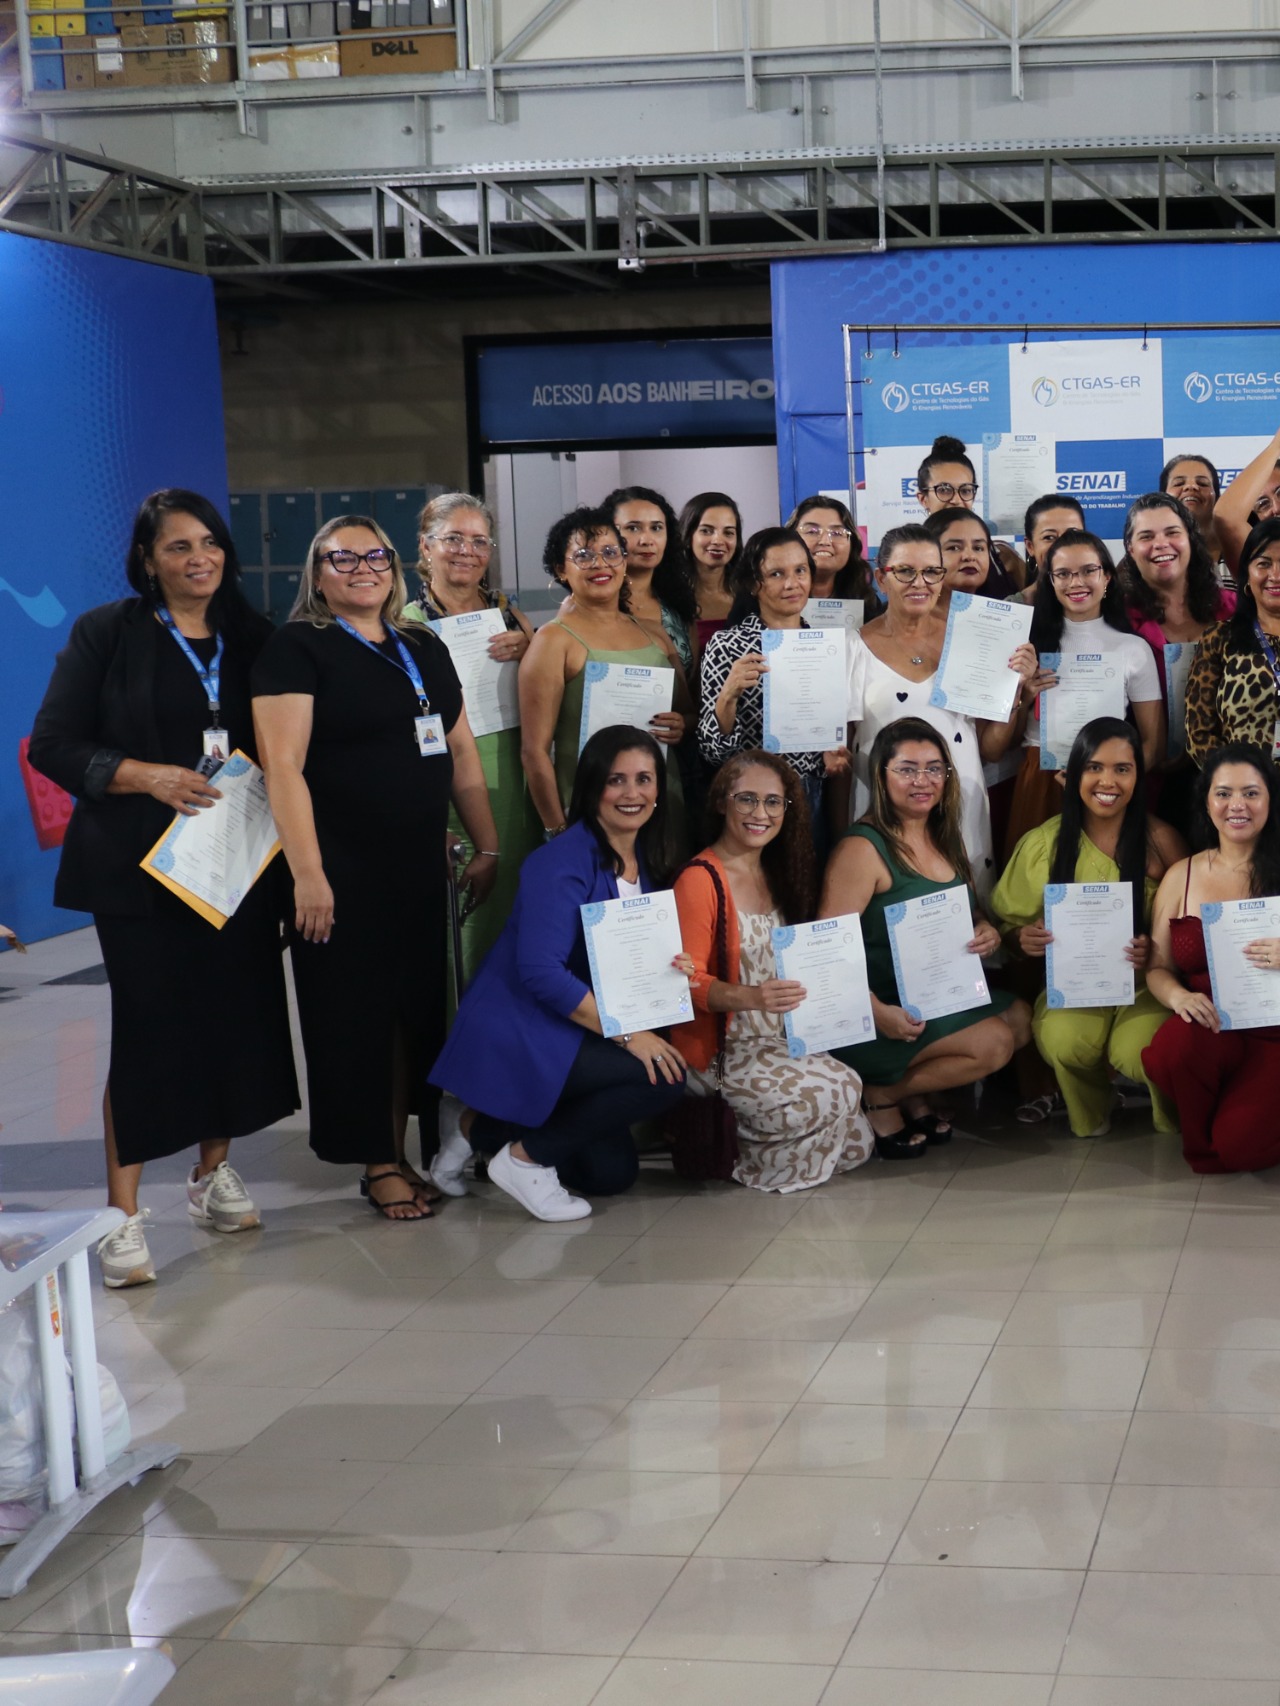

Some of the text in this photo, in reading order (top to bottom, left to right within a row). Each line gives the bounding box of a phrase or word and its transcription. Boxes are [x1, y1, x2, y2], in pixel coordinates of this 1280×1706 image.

[372, 40, 418, 56] DELL
[911, 380, 989, 396] CTGAS-ER
[1062, 376, 1141, 390] CTGAS-ER
[532, 379, 775, 406] ACESSO AOS BANHEIRO
[1056, 474, 1120, 490] SENAI
[987, 601, 1010, 611] SENAI
[457, 614, 481, 624] SENAI
[626, 668, 651, 676] SENAI
[622, 896, 649, 908] SENAI
[921, 894, 946, 905] SENAI
[1239, 902, 1265, 910] SENAI
[812, 921, 838, 932] SENAI
